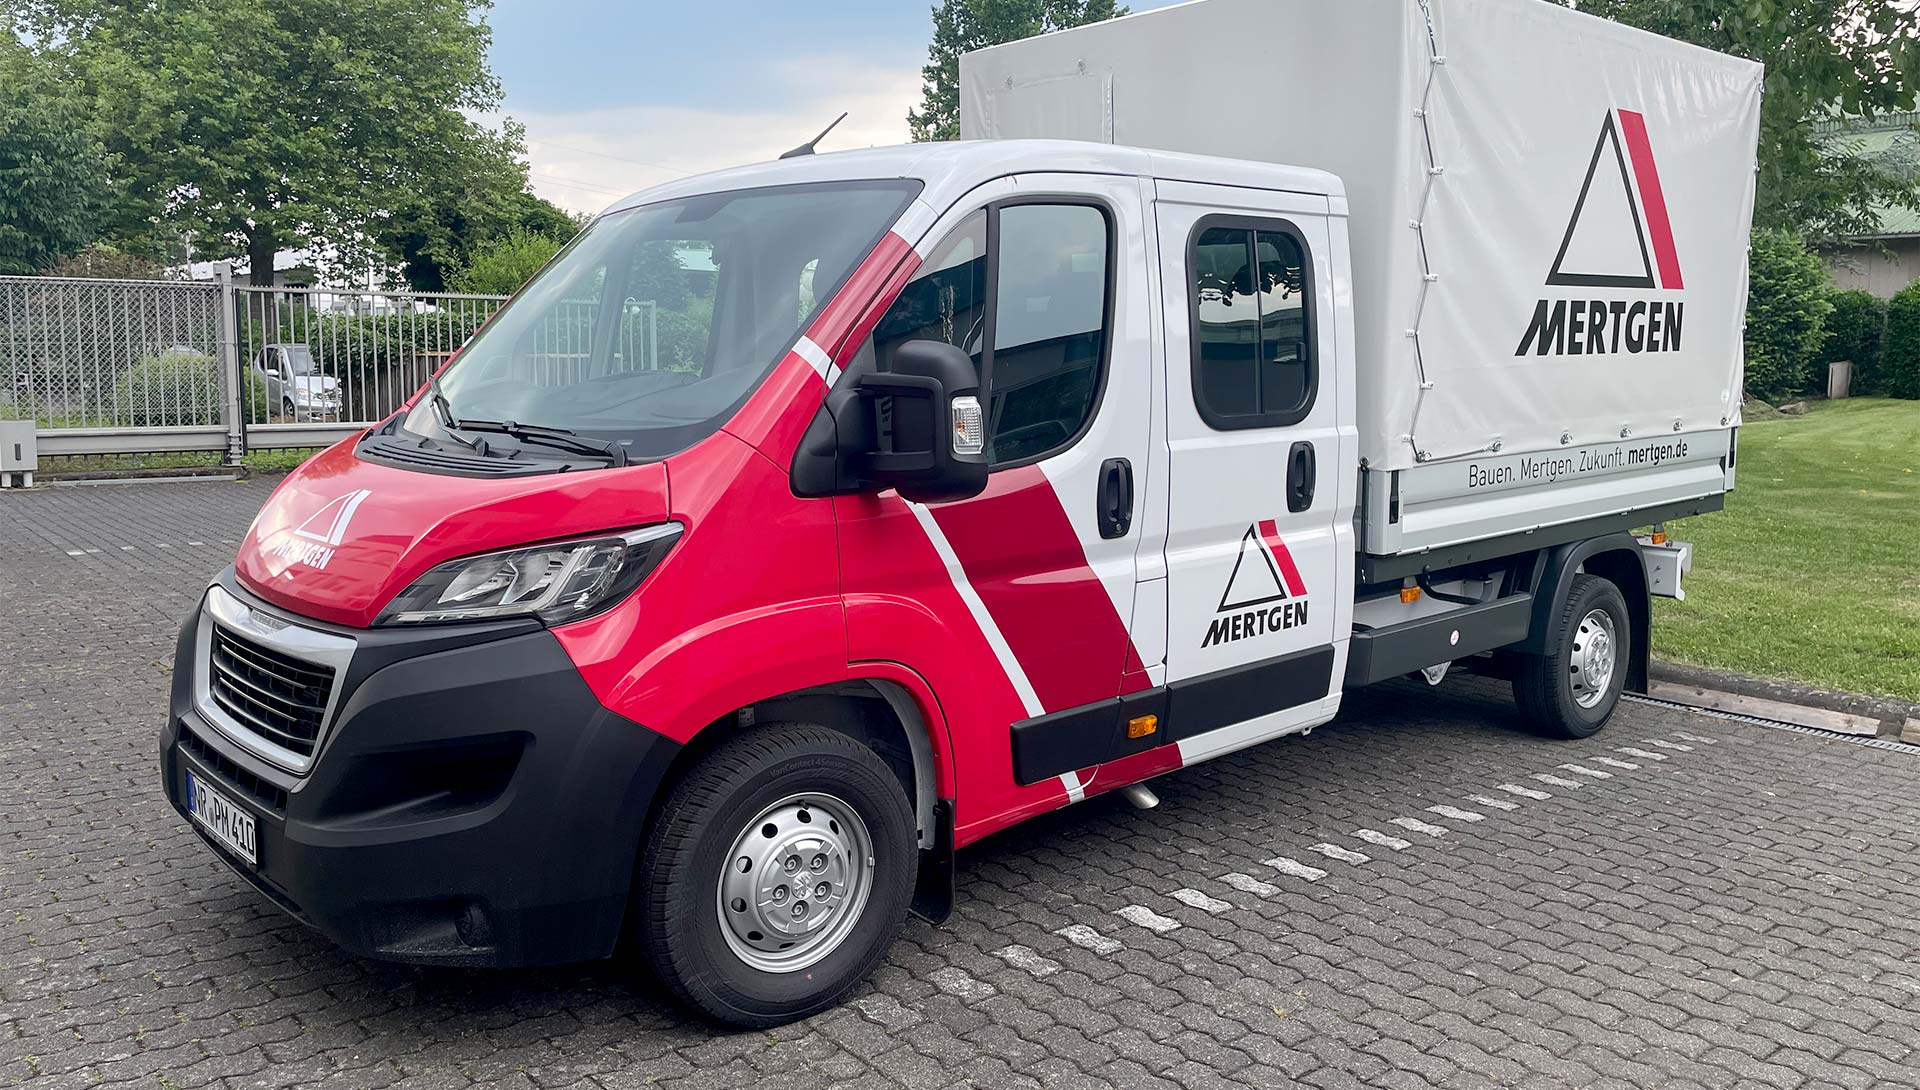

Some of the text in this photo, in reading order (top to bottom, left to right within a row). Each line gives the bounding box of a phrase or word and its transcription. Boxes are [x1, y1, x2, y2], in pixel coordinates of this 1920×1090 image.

[1514, 299, 1684, 356] MERTGEN
[1469, 438, 1688, 488] Bauen. Mertgen. Zukunft. mertgen.de
[1200, 600, 1308, 648] MERTGEN
[213, 796, 230, 839] PM
[232, 811, 255, 857] 410
